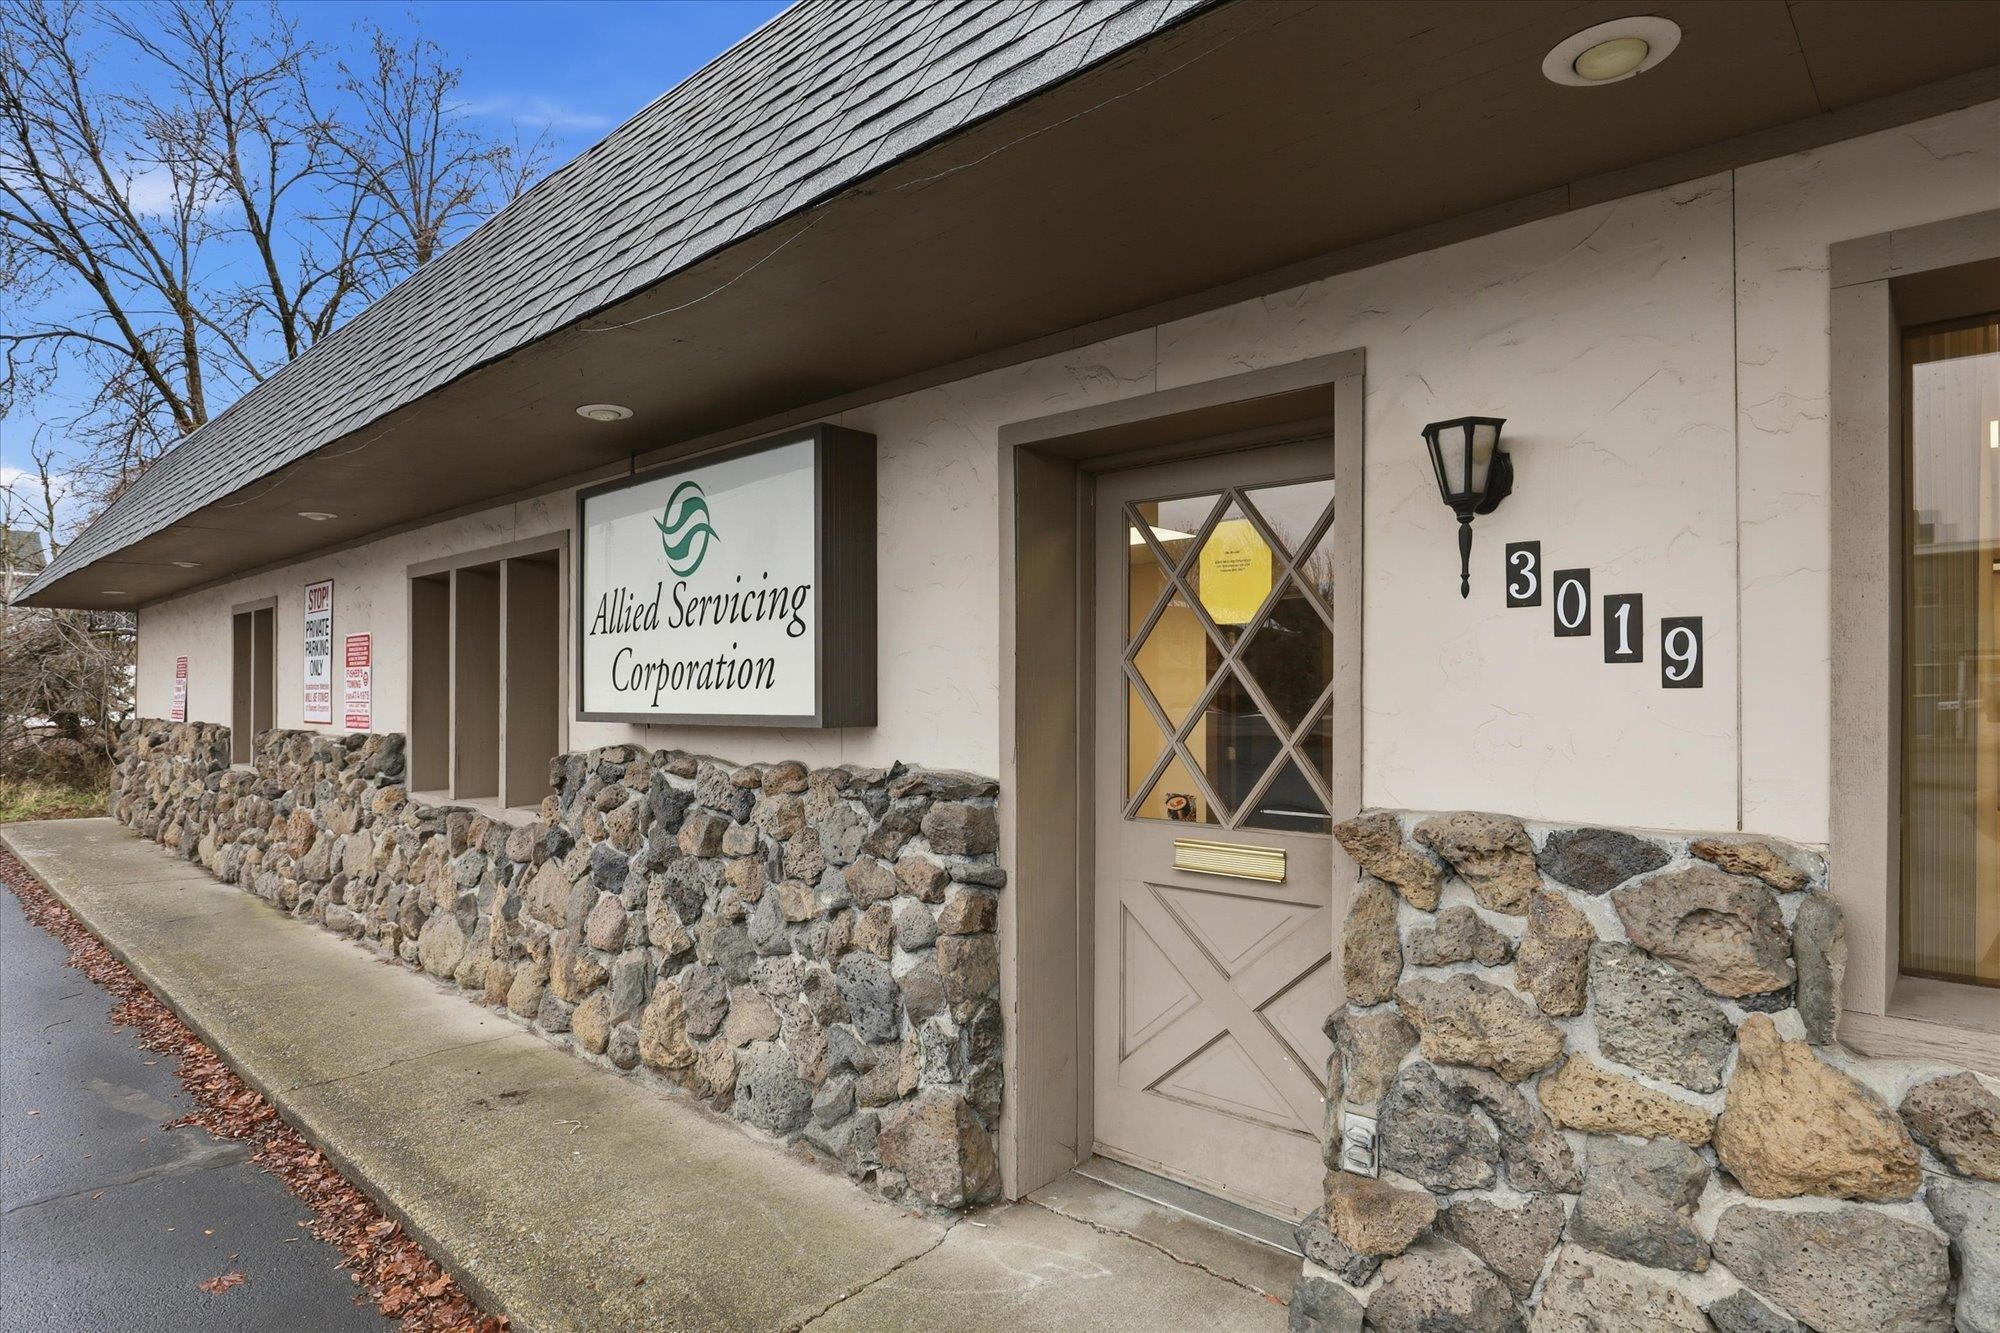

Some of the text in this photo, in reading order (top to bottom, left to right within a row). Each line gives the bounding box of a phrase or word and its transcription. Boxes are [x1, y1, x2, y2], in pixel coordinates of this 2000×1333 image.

[308, 586, 329, 611] STOP!
[589, 571, 811, 638] Allied Servicing
[305, 618, 329, 638] PRIVATE
[1509, 550, 1698, 681] 3019
[305, 639, 329, 657] PARKING
[309, 660, 323, 676] ONLY
[611, 642, 776, 707] Corporation
